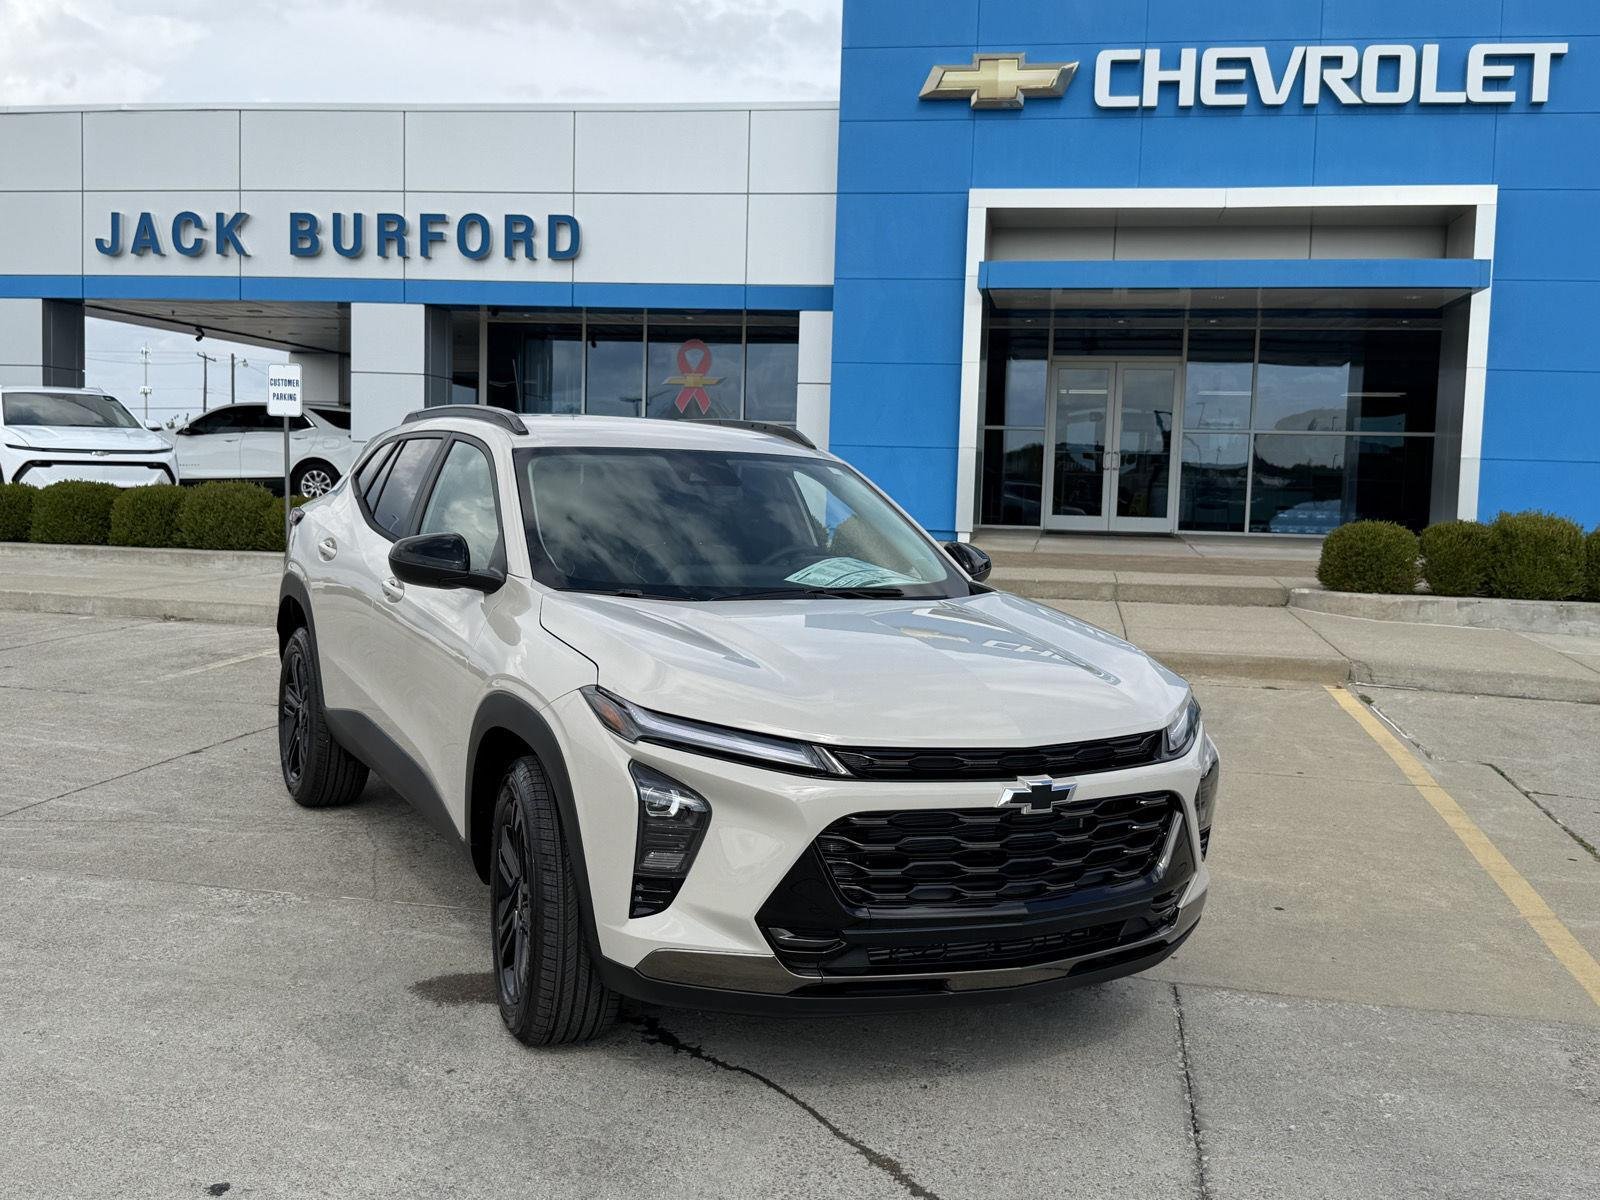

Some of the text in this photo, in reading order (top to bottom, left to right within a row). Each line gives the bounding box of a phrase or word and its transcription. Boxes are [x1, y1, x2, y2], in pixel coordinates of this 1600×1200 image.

[1094, 42, 1568, 109] CHEVROLET
[95, 211, 581, 260] JACK BURFORD
[270, 378, 300, 387] CUSTOMER
[272, 392, 296, 401] PARKING
